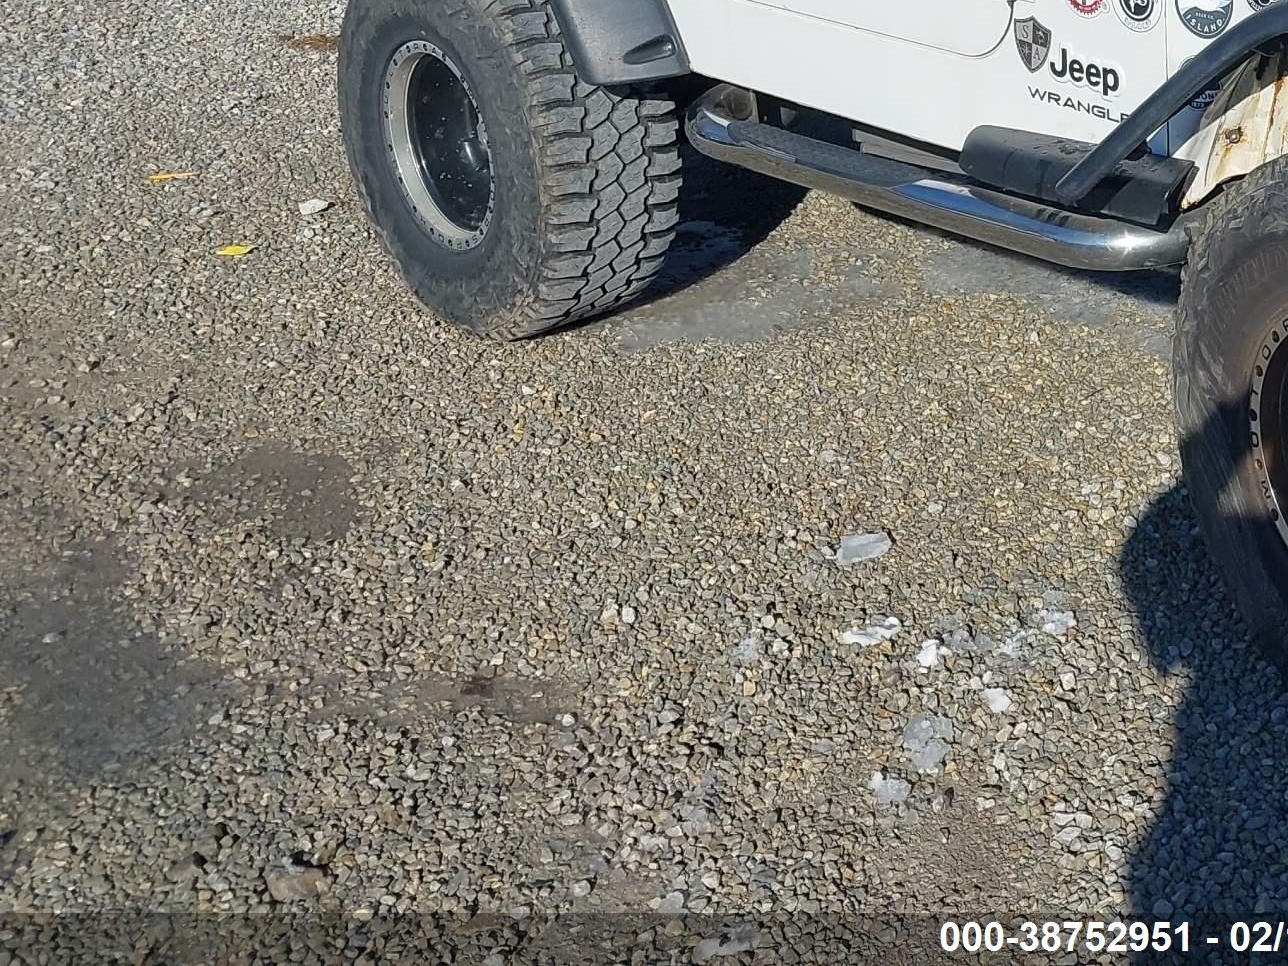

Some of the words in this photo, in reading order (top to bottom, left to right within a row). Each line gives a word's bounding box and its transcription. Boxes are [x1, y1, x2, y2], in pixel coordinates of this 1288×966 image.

[1022, 24, 1029, 39] S
[1033, 46, 1041, 61] A
[1050, 48, 1120, 96] Jeep
[1028, 86, 1130, 123] WRANGLE
